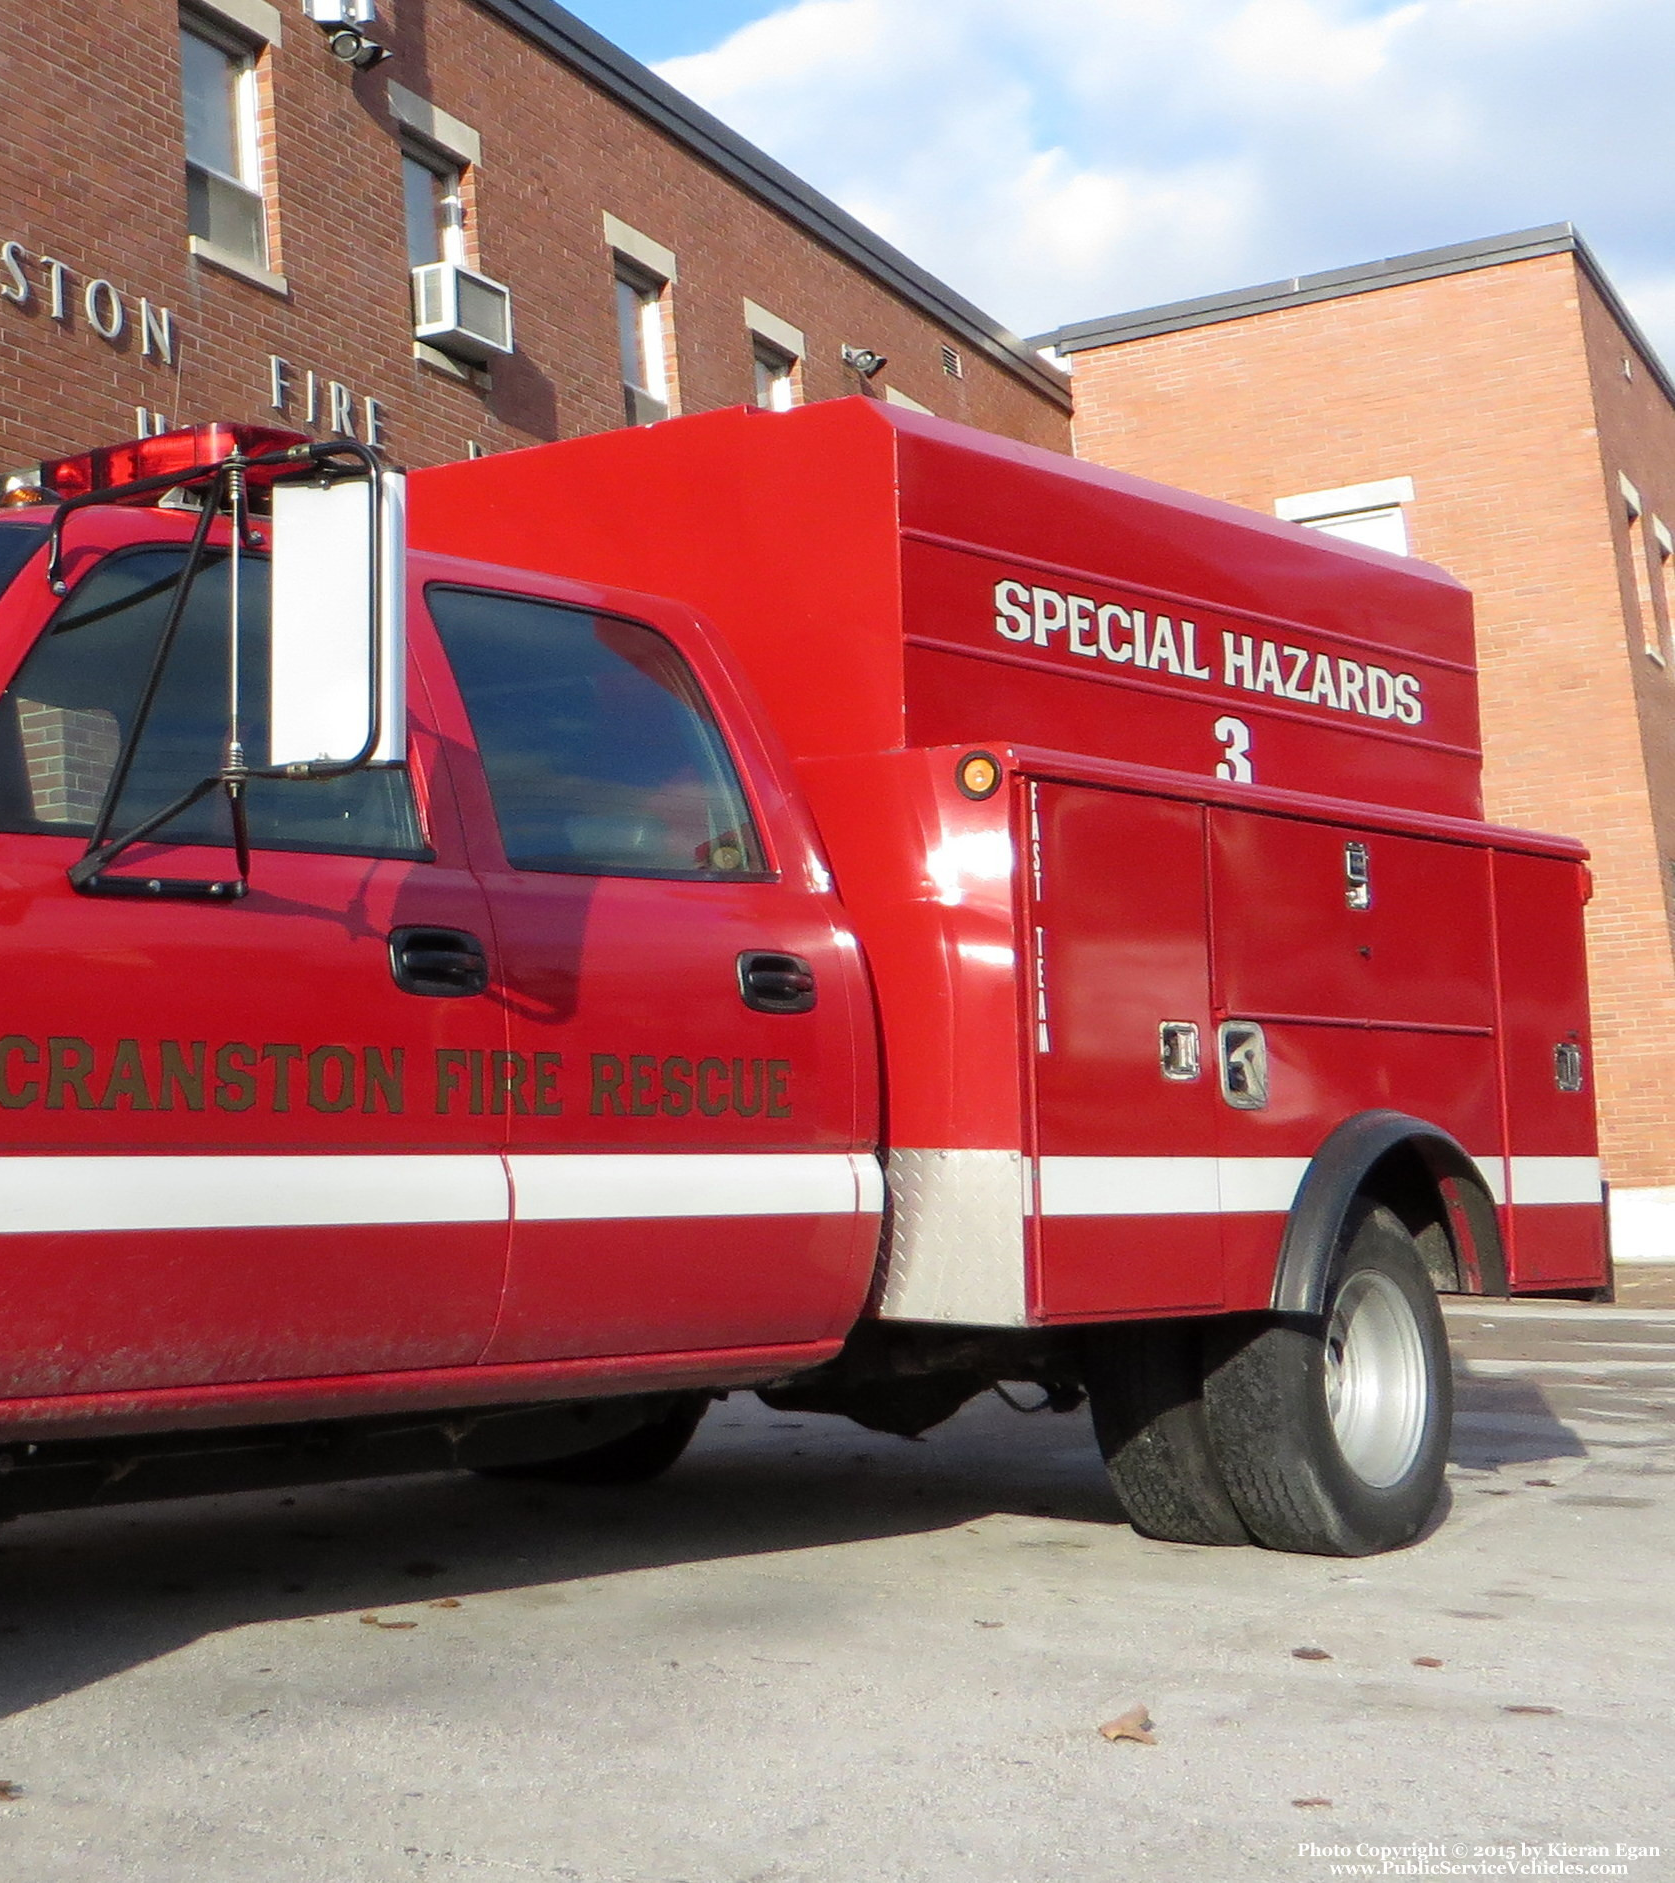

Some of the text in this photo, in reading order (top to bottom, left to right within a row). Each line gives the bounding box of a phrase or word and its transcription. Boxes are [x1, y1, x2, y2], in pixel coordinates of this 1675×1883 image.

[269, 354, 386, 451] FIRE
[994, 578, 1423, 725] SPECIAL HAZARDS
[1213, 715, 1253, 784] 3
[1030, 780, 1051, 1053] FAST TEAM
[434, 1048, 564, 1117] FIRE
[589, 1054, 793, 1119] RESCUE
